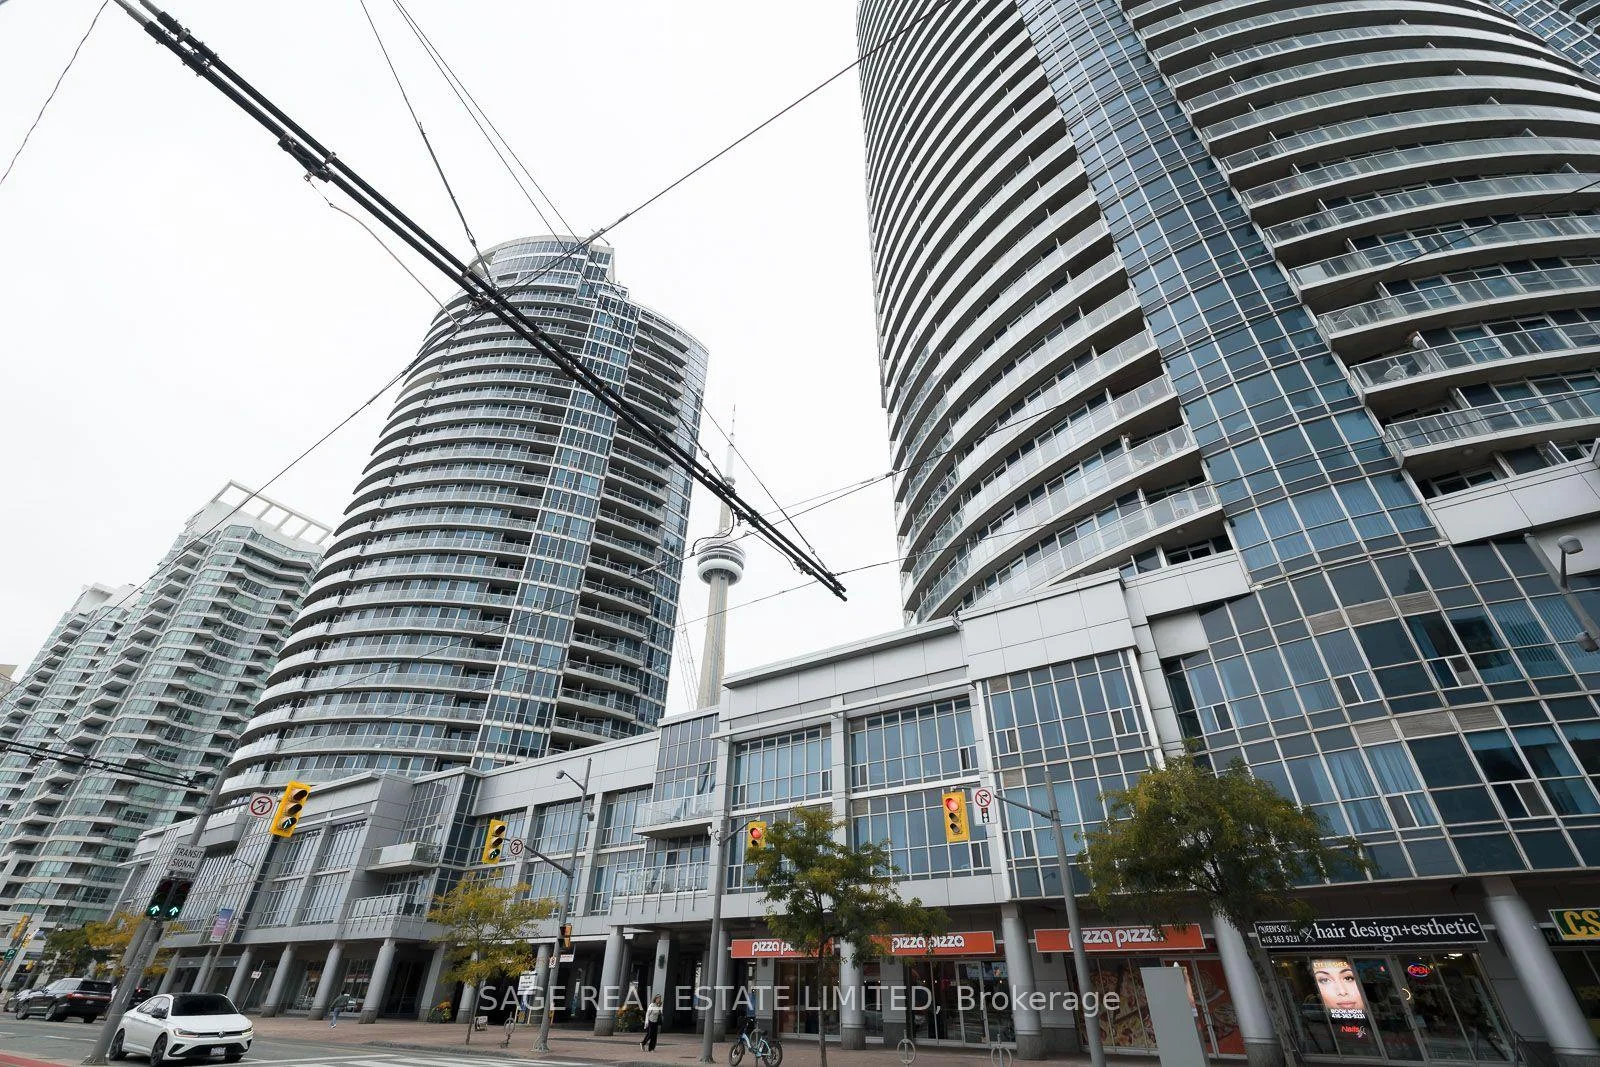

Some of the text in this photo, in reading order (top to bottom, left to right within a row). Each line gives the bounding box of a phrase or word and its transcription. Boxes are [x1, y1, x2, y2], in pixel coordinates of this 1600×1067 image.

[175, 848, 203, 859] TRANSIT
[171, 858, 196, 869] SIGNAL
[1313, 918, 1479, 942] hair design+esthetic
[892, 935, 964, 951] pizza pizza
[1262, 935, 1273, 943] 416
[1286, 935, 1301, 943] 9231
[751, 941, 779, 955] pizza
[1409, 966, 1429, 974] OPEN
